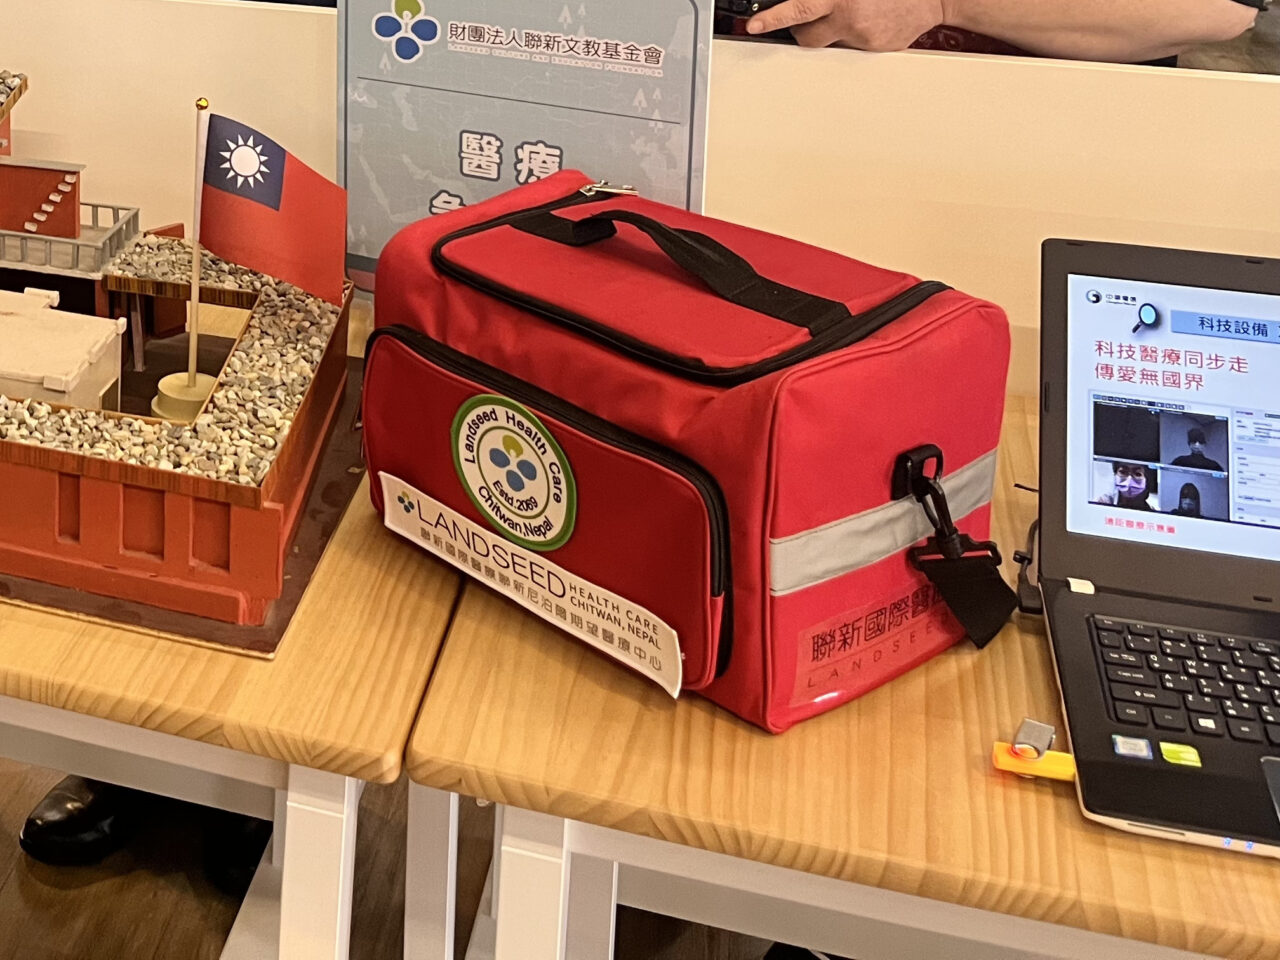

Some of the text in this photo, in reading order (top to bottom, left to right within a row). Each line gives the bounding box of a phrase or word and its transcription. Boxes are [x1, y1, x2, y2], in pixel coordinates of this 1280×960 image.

[448, 23, 663, 66] 財團法人聯新文教基金會
[460, 130, 563, 184] 醫療
[1198, 316, 1269, 338] 科技設備
[1094, 339, 1250, 374] 科技醫療同步走
[1094, 362, 1205, 391] 傳愛無國界
[464, 407, 562, 504] Landseed Health Care
[417, 499, 566, 599] LANDSEED
[569, 582, 658, 636] HEALTH CARE
[627, 624, 661, 650] NEPAL
